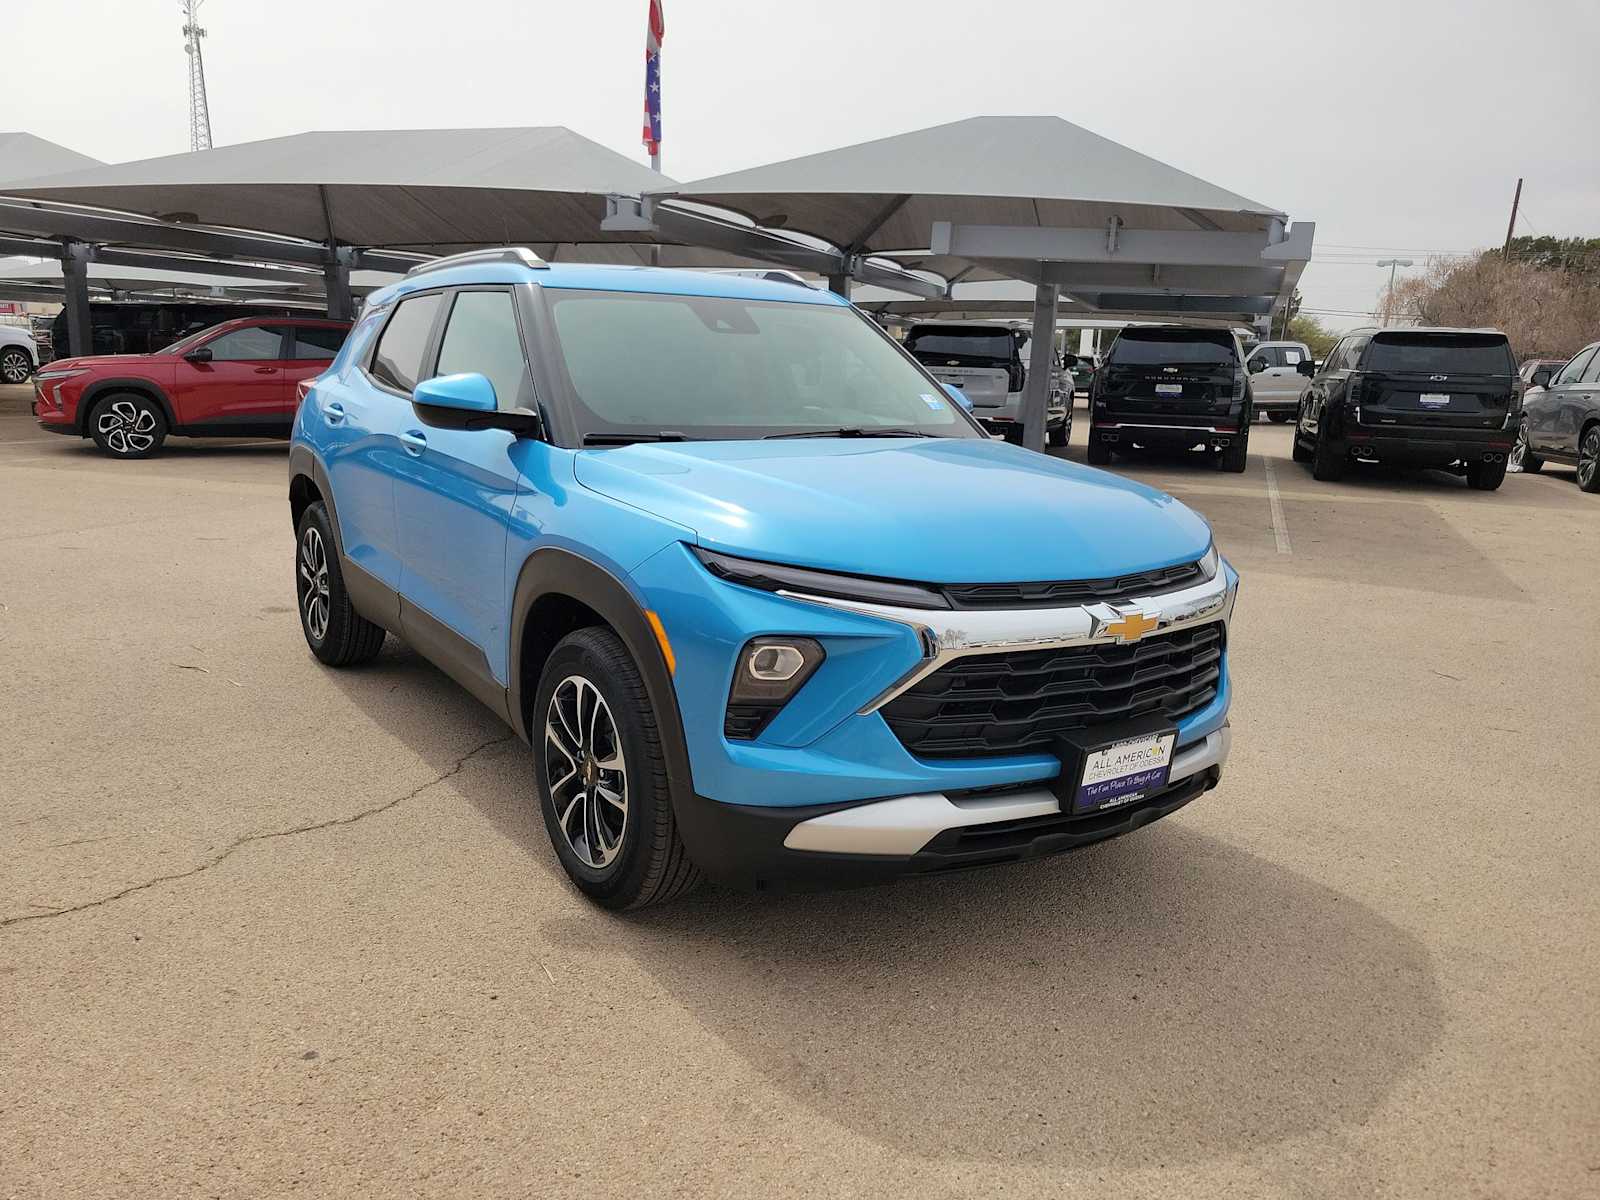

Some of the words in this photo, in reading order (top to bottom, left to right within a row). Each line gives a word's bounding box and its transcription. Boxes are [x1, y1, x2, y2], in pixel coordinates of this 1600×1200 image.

[1088, 764, 1128, 780] CHEVROLET
[1129, 762, 1139, 770] OF
[1139, 756, 1165, 767] ODESSA
[1093, 758, 1111, 769] ALL
[1086, 785, 1098, 796] The
[1098, 785, 1109, 793] Fun
[1110, 780, 1126, 790] Place
[1126, 777, 1135, 785] To
[1134, 773, 1146, 785] Buy
[1151, 770, 1162, 780] Car
